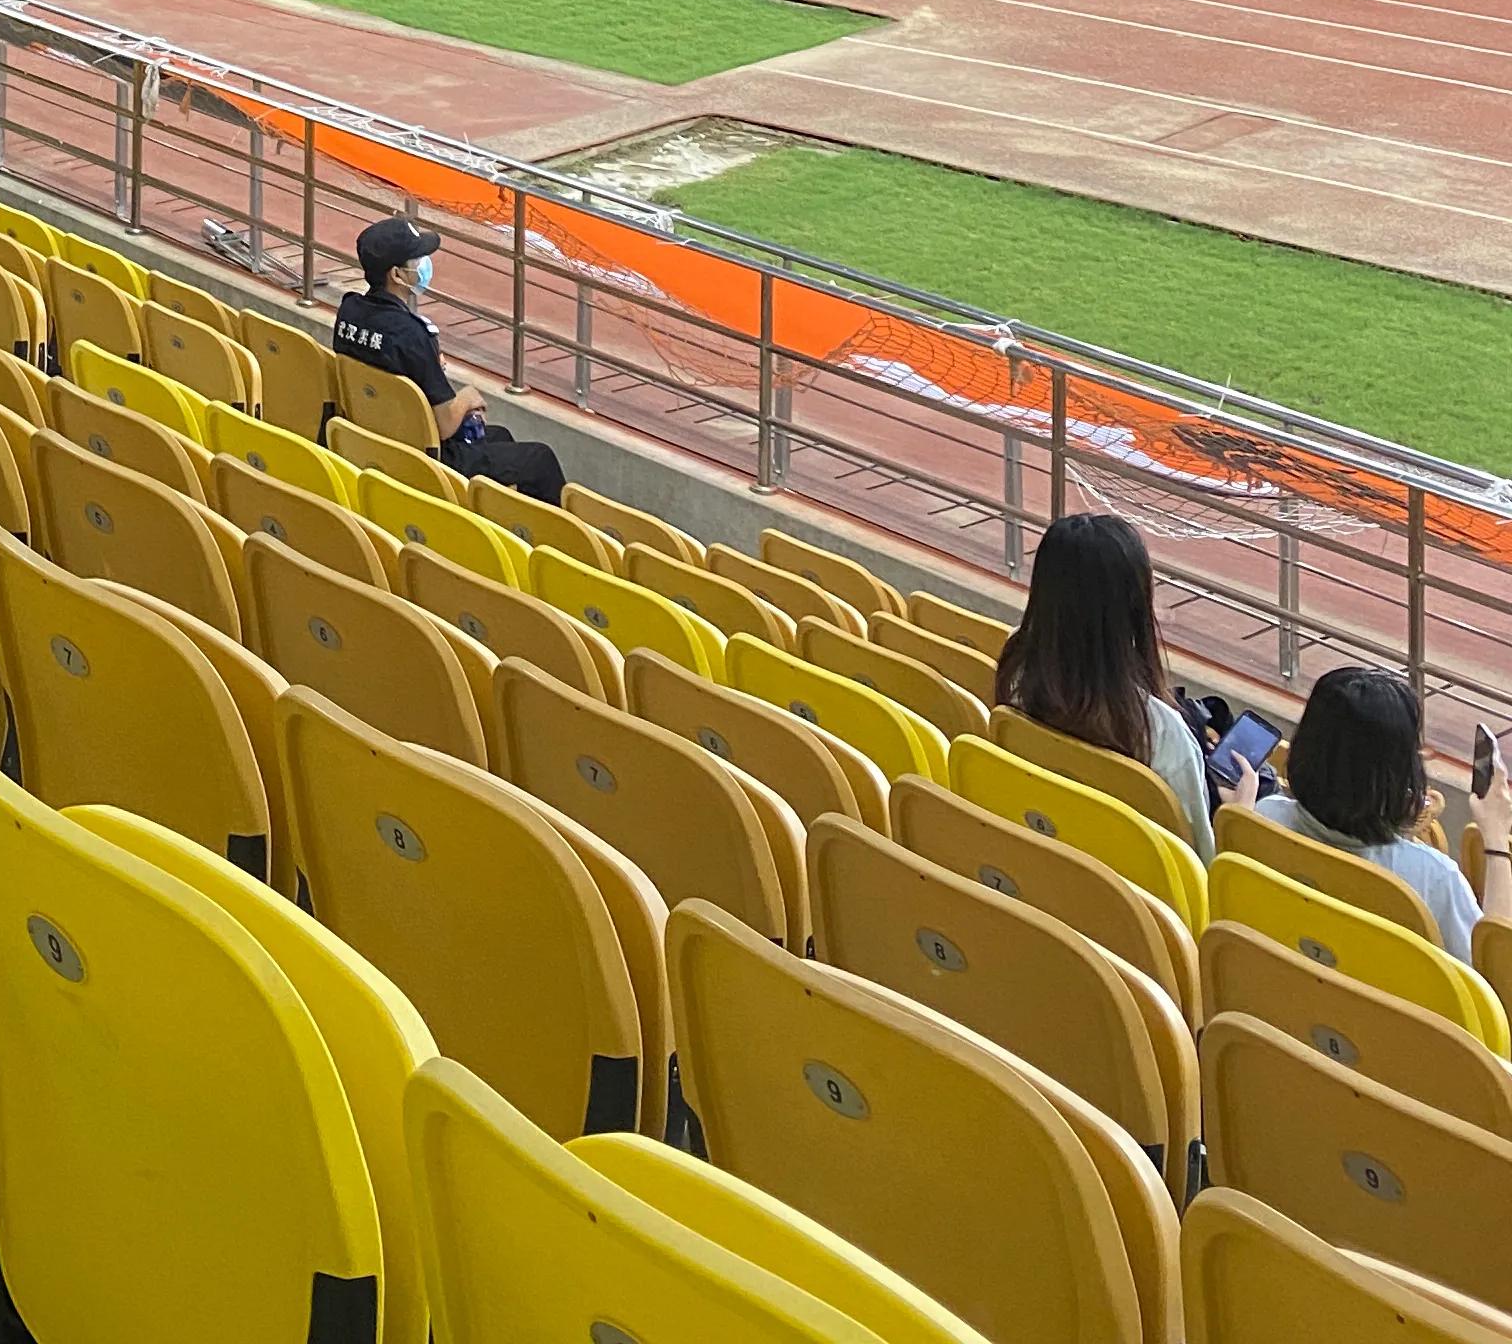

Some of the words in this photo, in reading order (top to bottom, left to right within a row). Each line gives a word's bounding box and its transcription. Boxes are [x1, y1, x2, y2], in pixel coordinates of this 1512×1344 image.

[94, 512, 103, 525] 5
[319, 626, 328, 642] 6
[63, 648, 73, 666] 7
[589, 766, 599, 783] 7
[394, 828, 405, 850] 8
[993, 876, 1003, 890] 7
[48, 934, 62, 963] 9
[934, 941, 946, 961] 8
[1329, 1038, 1340, 1055] 8
[827, 1079, 842, 1103] 9
[1365, 1168, 1379, 1189] 9
